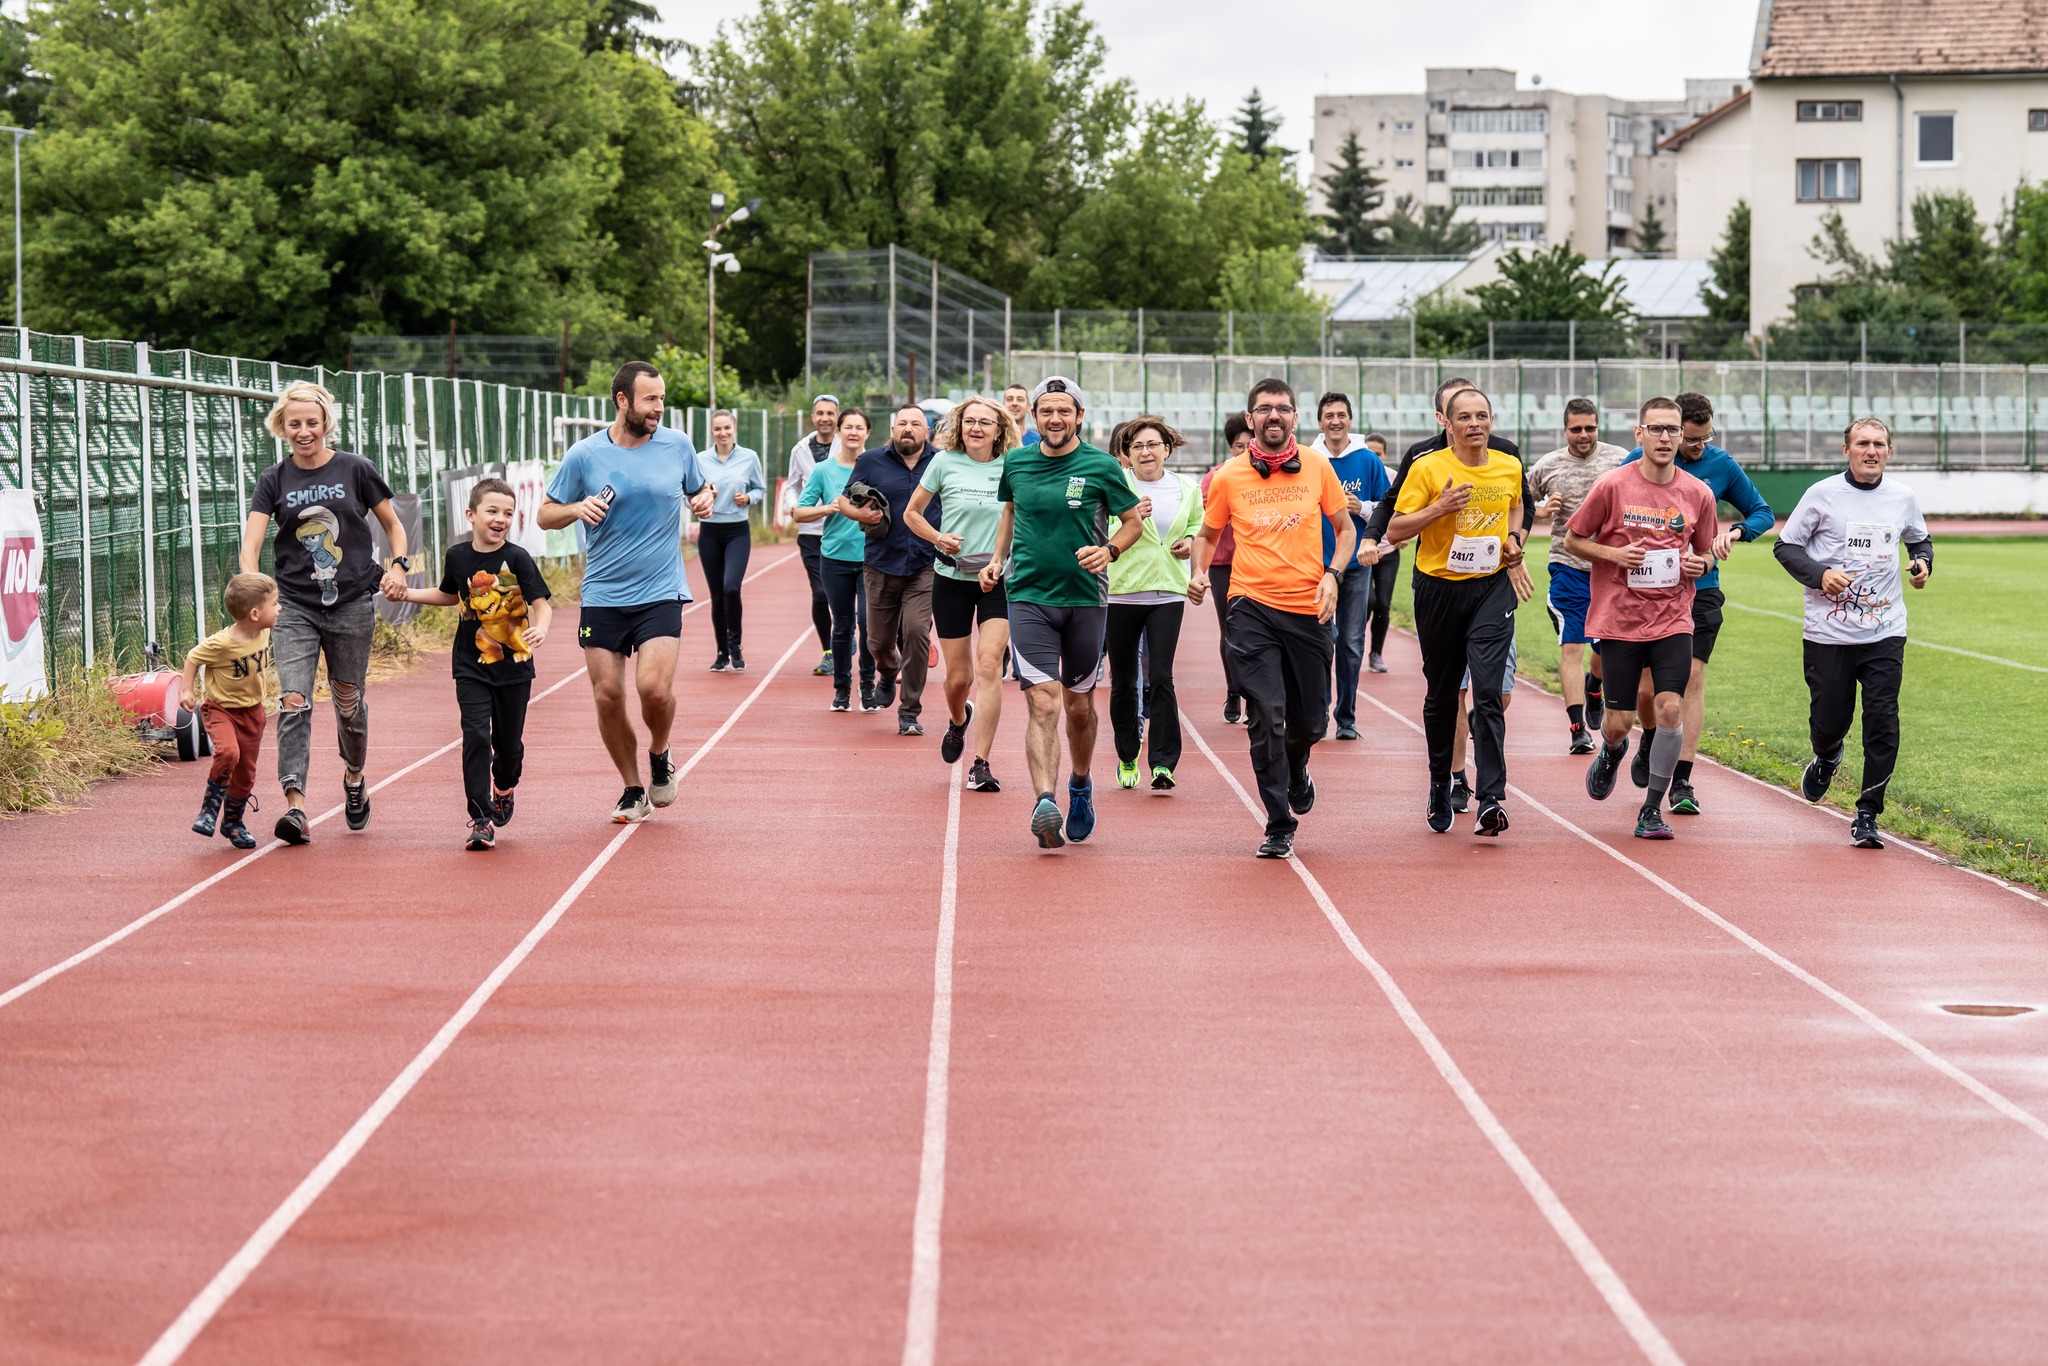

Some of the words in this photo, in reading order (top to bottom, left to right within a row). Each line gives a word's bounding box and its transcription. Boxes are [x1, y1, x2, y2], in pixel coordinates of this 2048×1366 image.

[285, 483, 346, 509] SMURFS
[1241, 489, 1262, 500] VISIT
[1264, 485, 1310, 497] COVASNA
[1469, 493, 1503, 503] RATHON
[1249, 493, 1303, 507] MARATHON
[1623, 513, 1667, 525] MARATHON
[1847, 537, 1872, 549] 241/3
[1450, 550, 1475, 562] 241/2
[1629, 566, 1653, 577] 241/1
